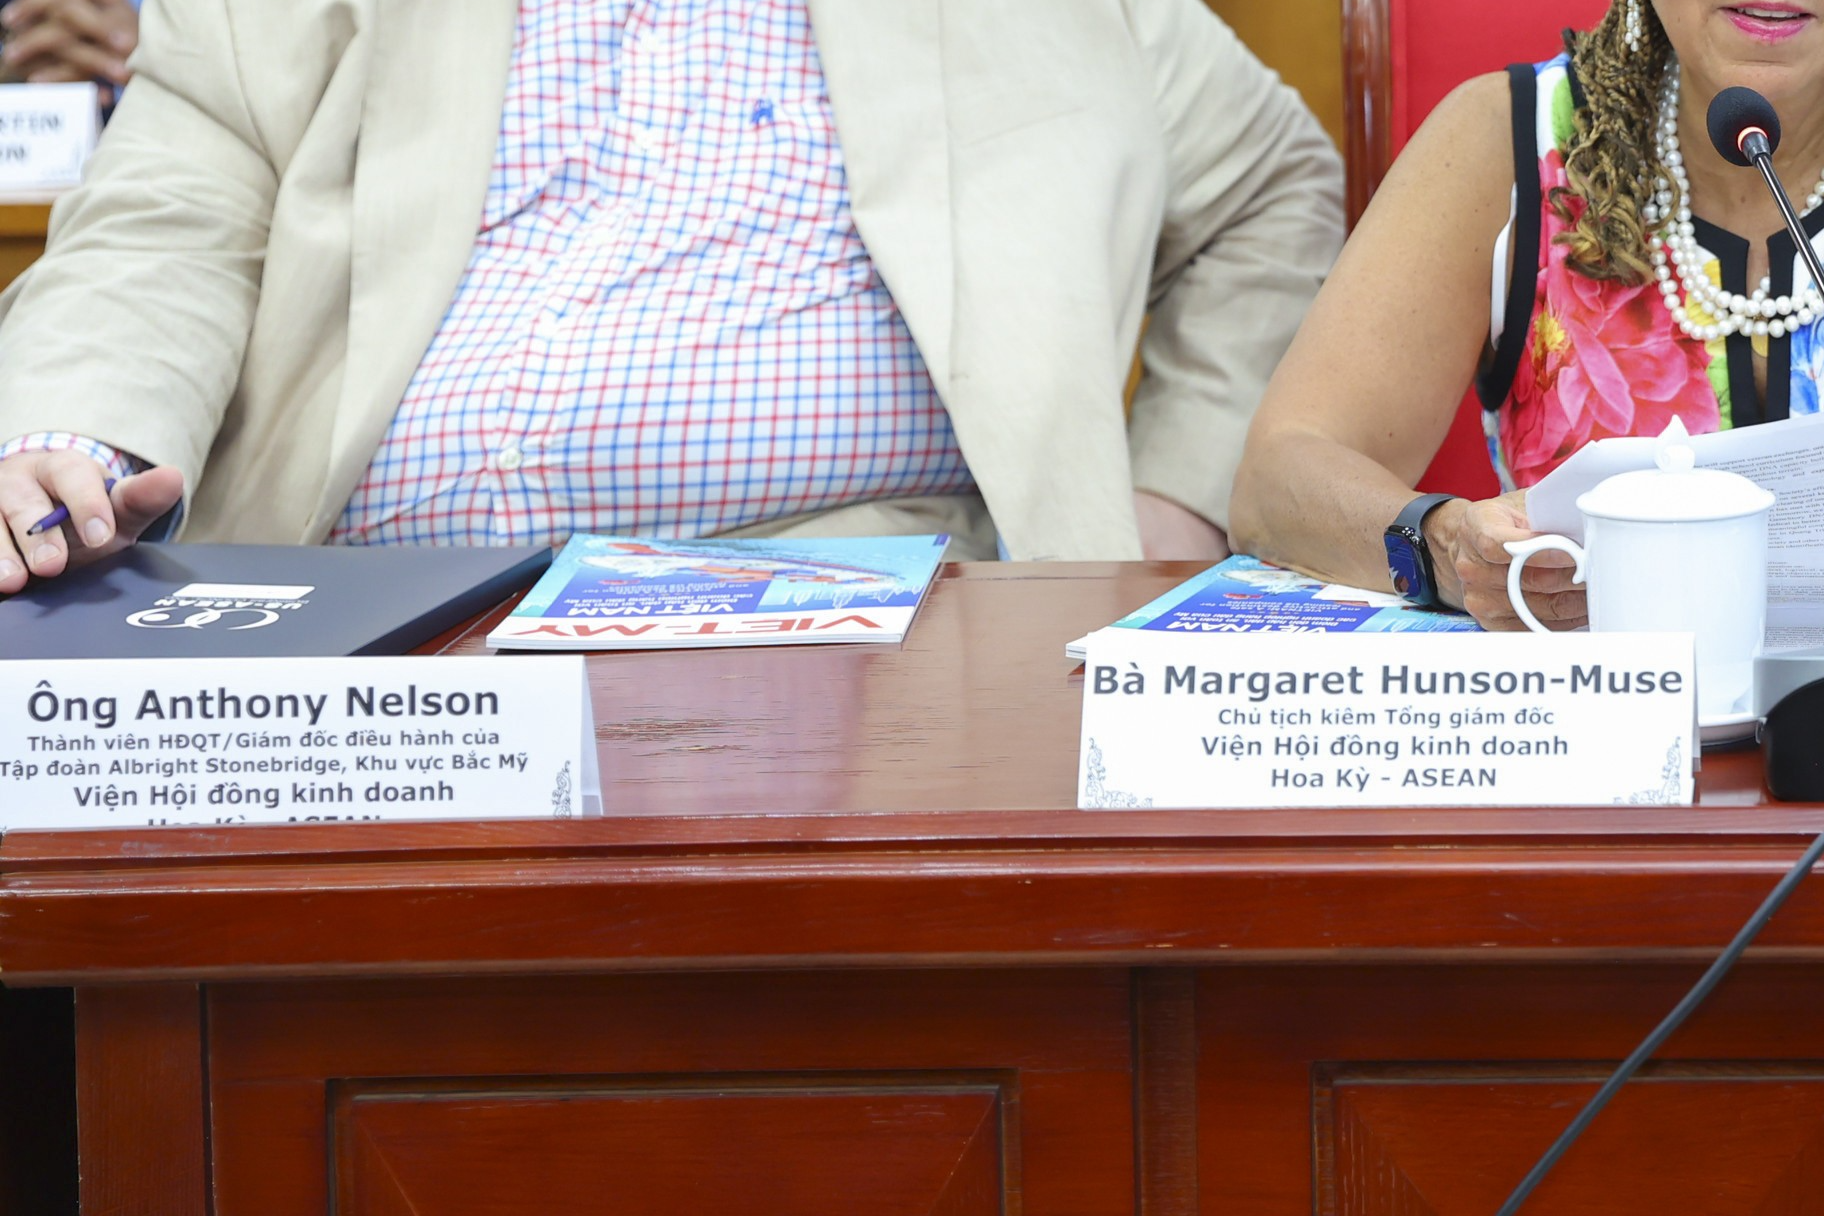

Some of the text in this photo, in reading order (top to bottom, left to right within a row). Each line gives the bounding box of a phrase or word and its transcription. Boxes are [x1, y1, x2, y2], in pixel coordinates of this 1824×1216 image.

[566, 605, 651, 616] NAM
[1094, 662, 1682, 702] Bà Margaret Hunson-Muse
[28, 680, 498, 729] Ông Anthony Nelson
[1219, 707, 1553, 728] Chủ tịch kiêm Tổng giám đốc
[27, 728, 499, 752] Thành viên HĐQT/Giám đốc điều hành của
[1202, 735, 1567, 760] Viện Hội đồng kinh doanh
[0, 750, 528, 780] Tập đoàn Albright Stonebridge, Khu vực Bắc Mỹ
[1272, 769, 1323, 787] Hoa
[1337, 767, 1369, 792] Kỳ
[1402, 768, 1496, 787] ASEAN
[73, 780, 453, 811] Viện Hội đồng kinh doanh
